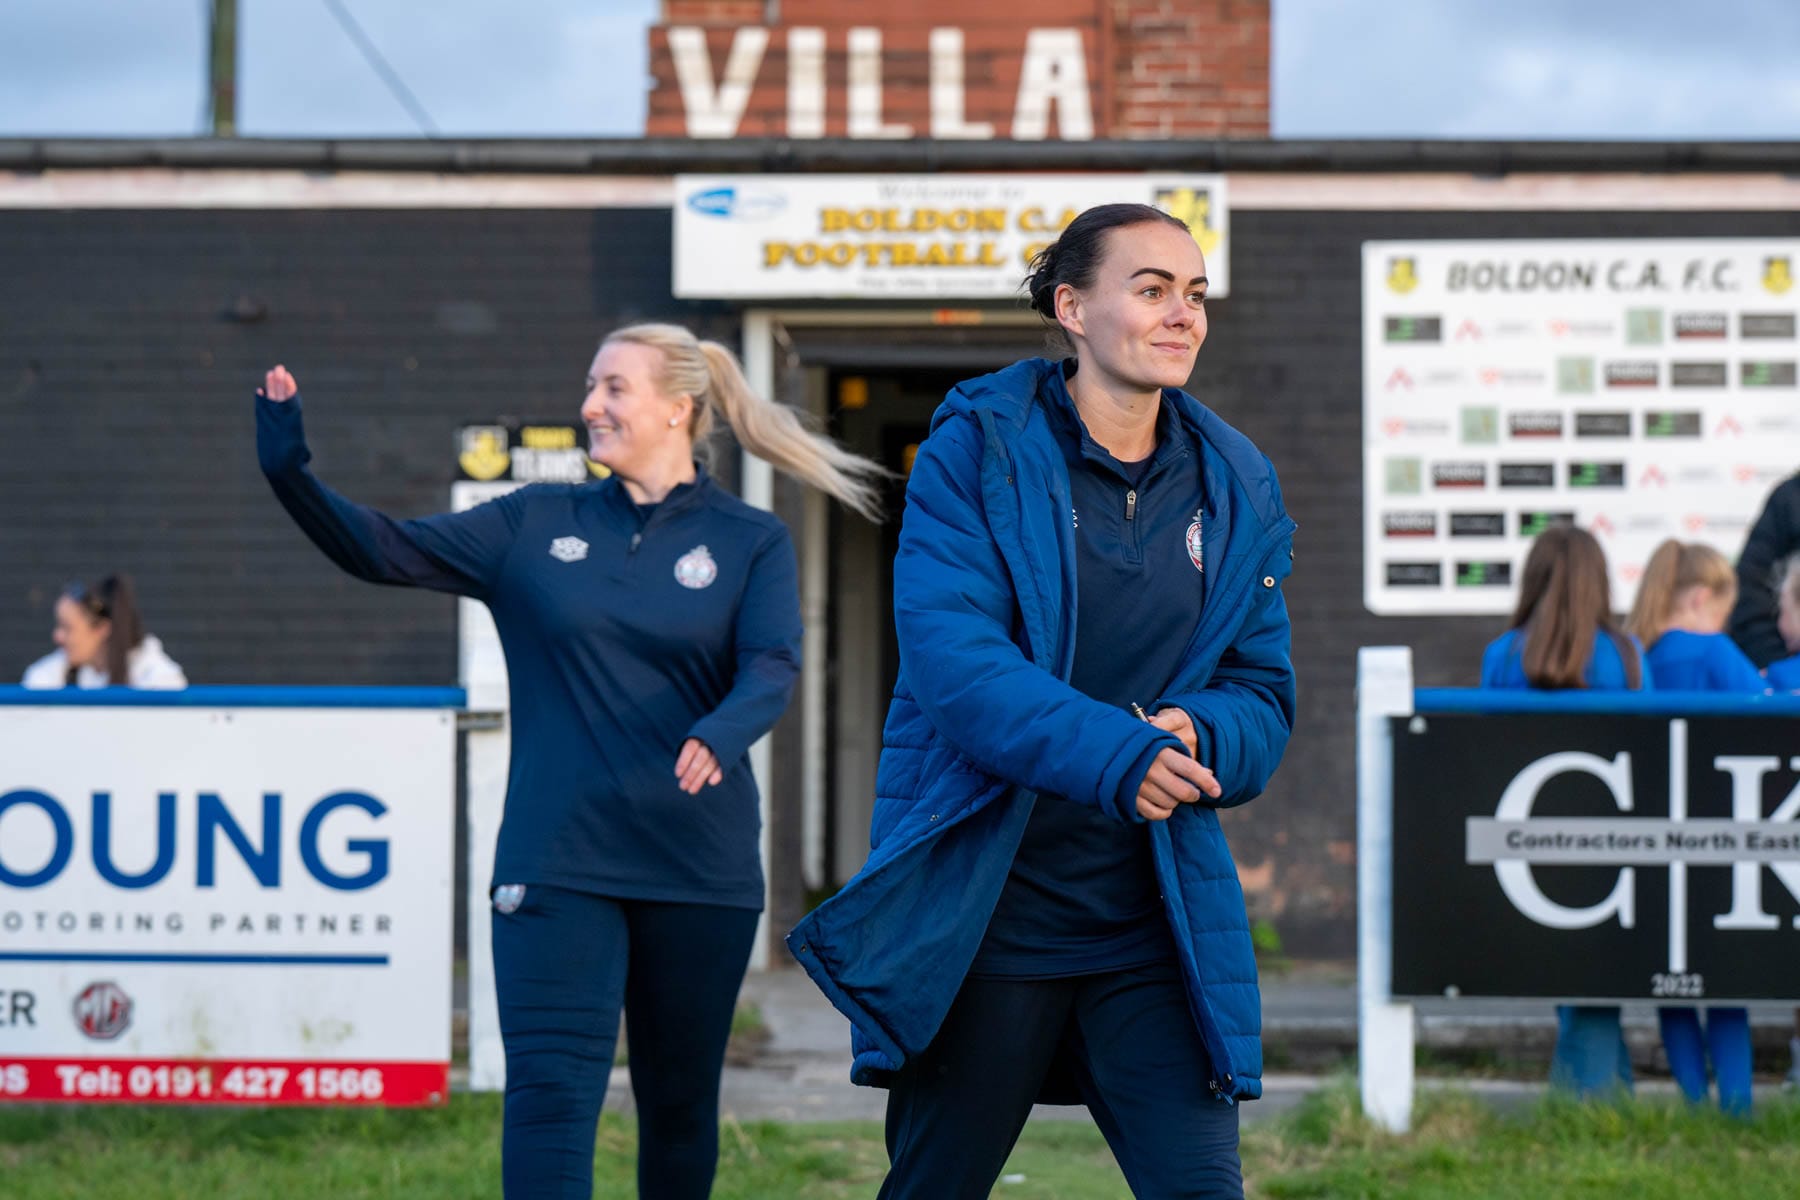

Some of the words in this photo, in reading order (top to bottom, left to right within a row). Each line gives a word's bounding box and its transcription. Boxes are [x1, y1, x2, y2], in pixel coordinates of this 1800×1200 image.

[667, 27, 1094, 138] VILLA
[821, 207, 1006, 233] BOLDON
[762, 242, 1006, 268] FOOTBALL
[1447, 259, 1595, 291] BOLDON
[0, 787, 390, 891] OUNG
[1494, 751, 1635, 929] C
[1506, 829, 1656, 850] Contractors
[1666, 831, 1736, 850] North
[1746, 832, 1800, 851] East
[3, 910, 183, 933] OTORING
[209, 913, 392, 934] PARTNER
[1652, 973, 1703, 997] 2022
[56, 1065, 121, 1096] Tel:
[129, 1066, 213, 1097] 0191
[222, 1068, 289, 1098] 427
[297, 1068, 384, 1099] 1566
